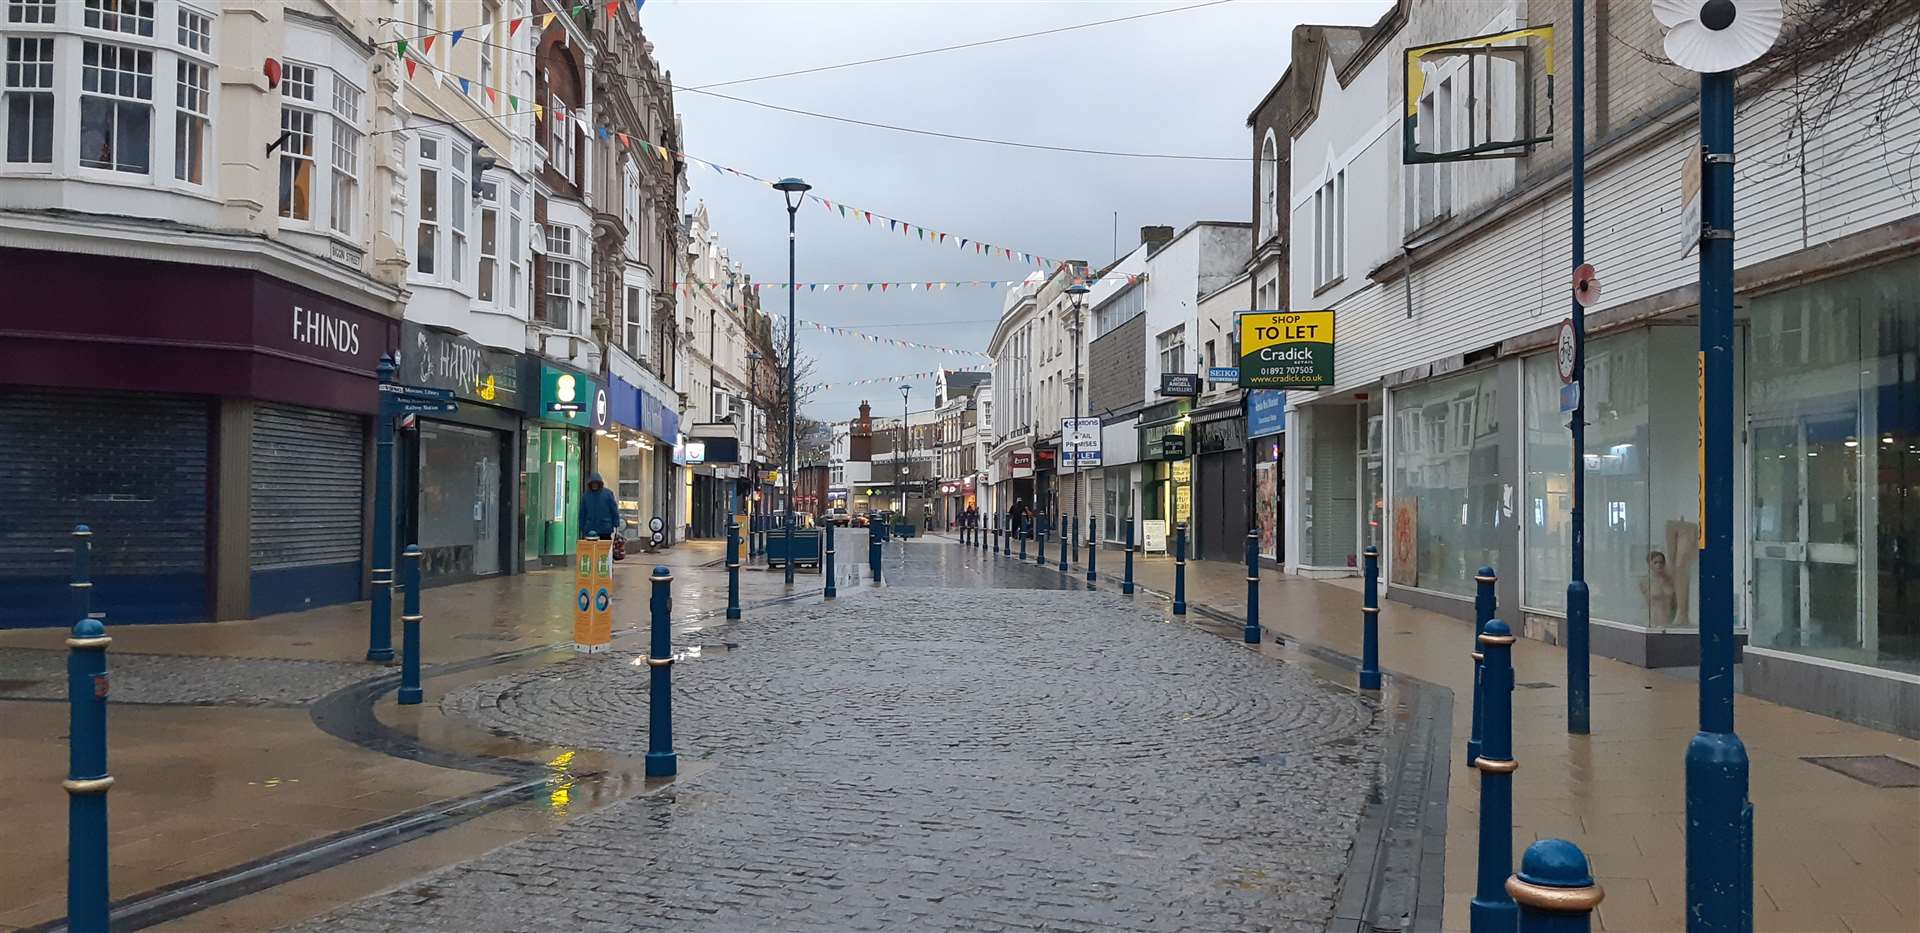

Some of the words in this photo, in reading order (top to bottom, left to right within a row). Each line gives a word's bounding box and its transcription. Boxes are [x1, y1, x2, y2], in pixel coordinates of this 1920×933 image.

[1272, 316, 1300, 324] SHOP
[293, 306, 359, 355] F.HINDS
[1255, 326, 1280, 340] TO
[1285, 325, 1318, 339] LET
[1260, 347, 1313, 361] Cradick
[1286, 366, 1314, 374] 707505
[1250, 374, 1322, 383] www.cradick.co.uk
